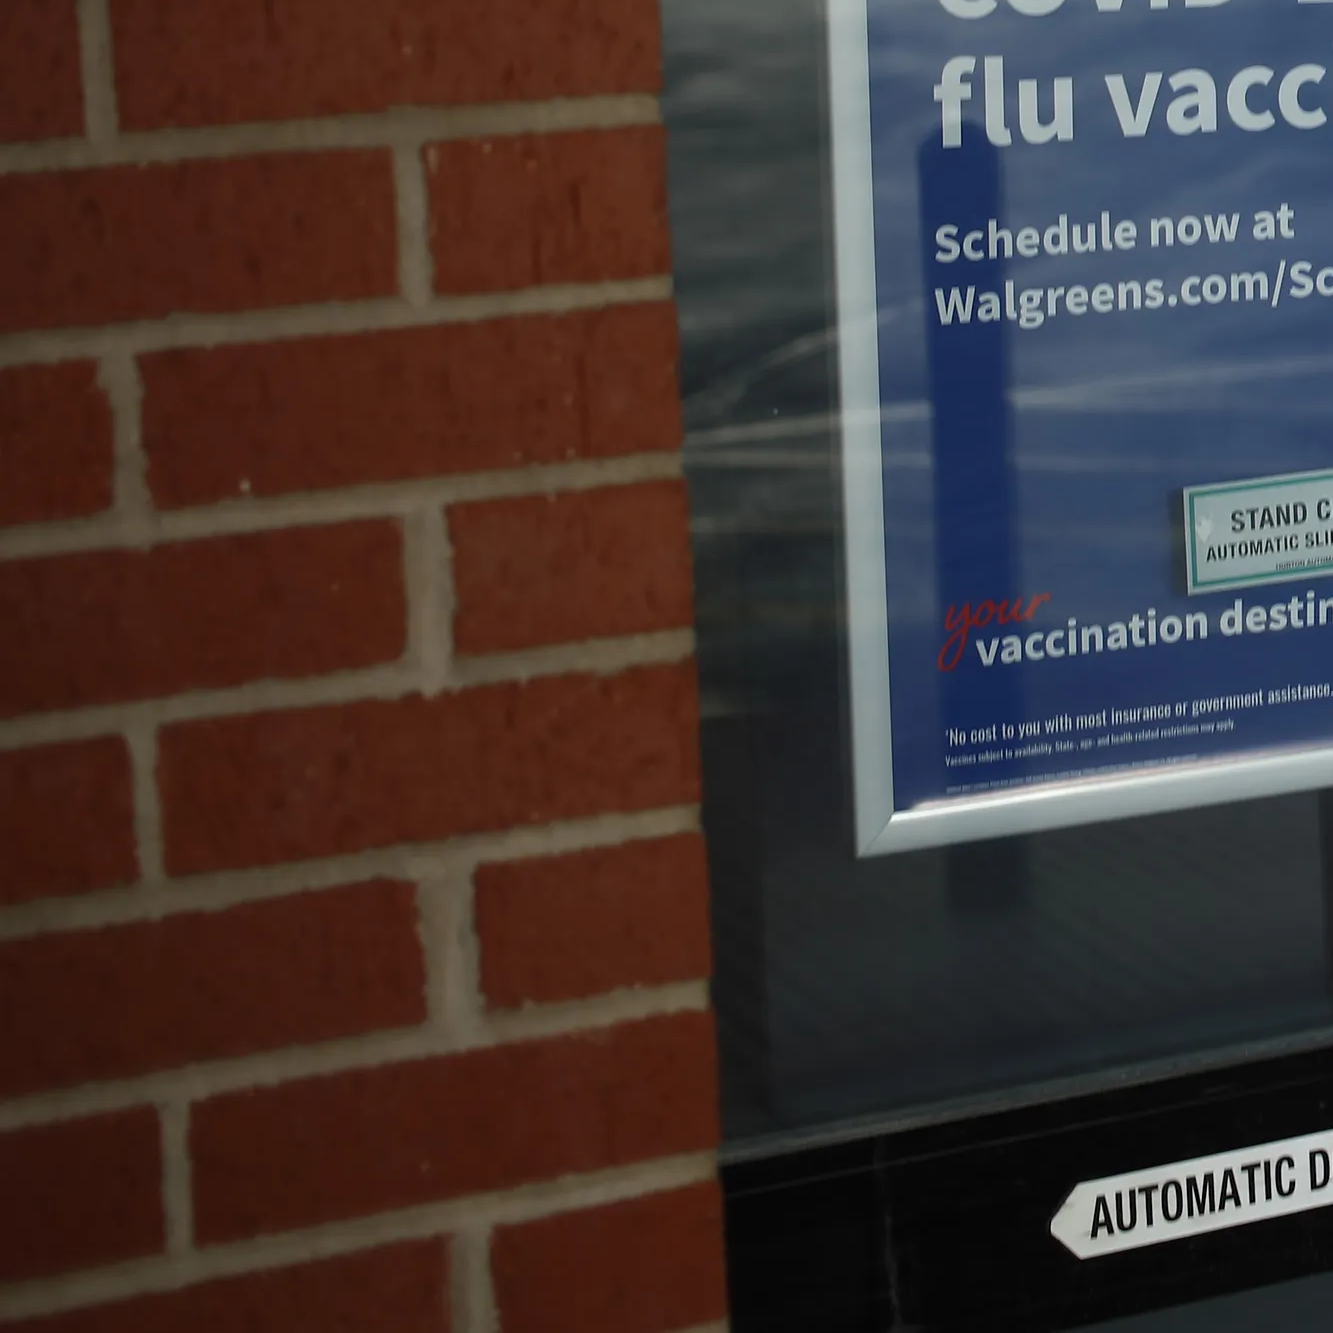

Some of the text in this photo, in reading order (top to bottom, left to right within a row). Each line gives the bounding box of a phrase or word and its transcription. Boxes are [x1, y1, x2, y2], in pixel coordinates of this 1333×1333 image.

[933, 56, 1075, 149] flu
[934, 204, 1294, 264] Schedule now at
[1230, 502, 1308, 533] STAND
[1206, 535, 1300, 563] AUTOMATIC
[937, 591, 1051, 673] your
[976, 607, 1208, 666] vaccination
[970, 724, 997, 745] cost
[1001, 722, 1015, 741] to
[1018, 720, 1040, 741] you
[1045, 713, 1073, 734] with
[1076, 708, 1107, 730] most
[1111, 702, 1171, 726] insurance
[1175, 700, 1188, 716] or
[1191, 688, 1264, 718] government
[1267, 682, 1333, 705] assistance.
[945, 750, 977, 768] Vaccines
[978, 749, 1003, 765] subject
[1089, 1156, 1297, 1240] AUTOMATIC
